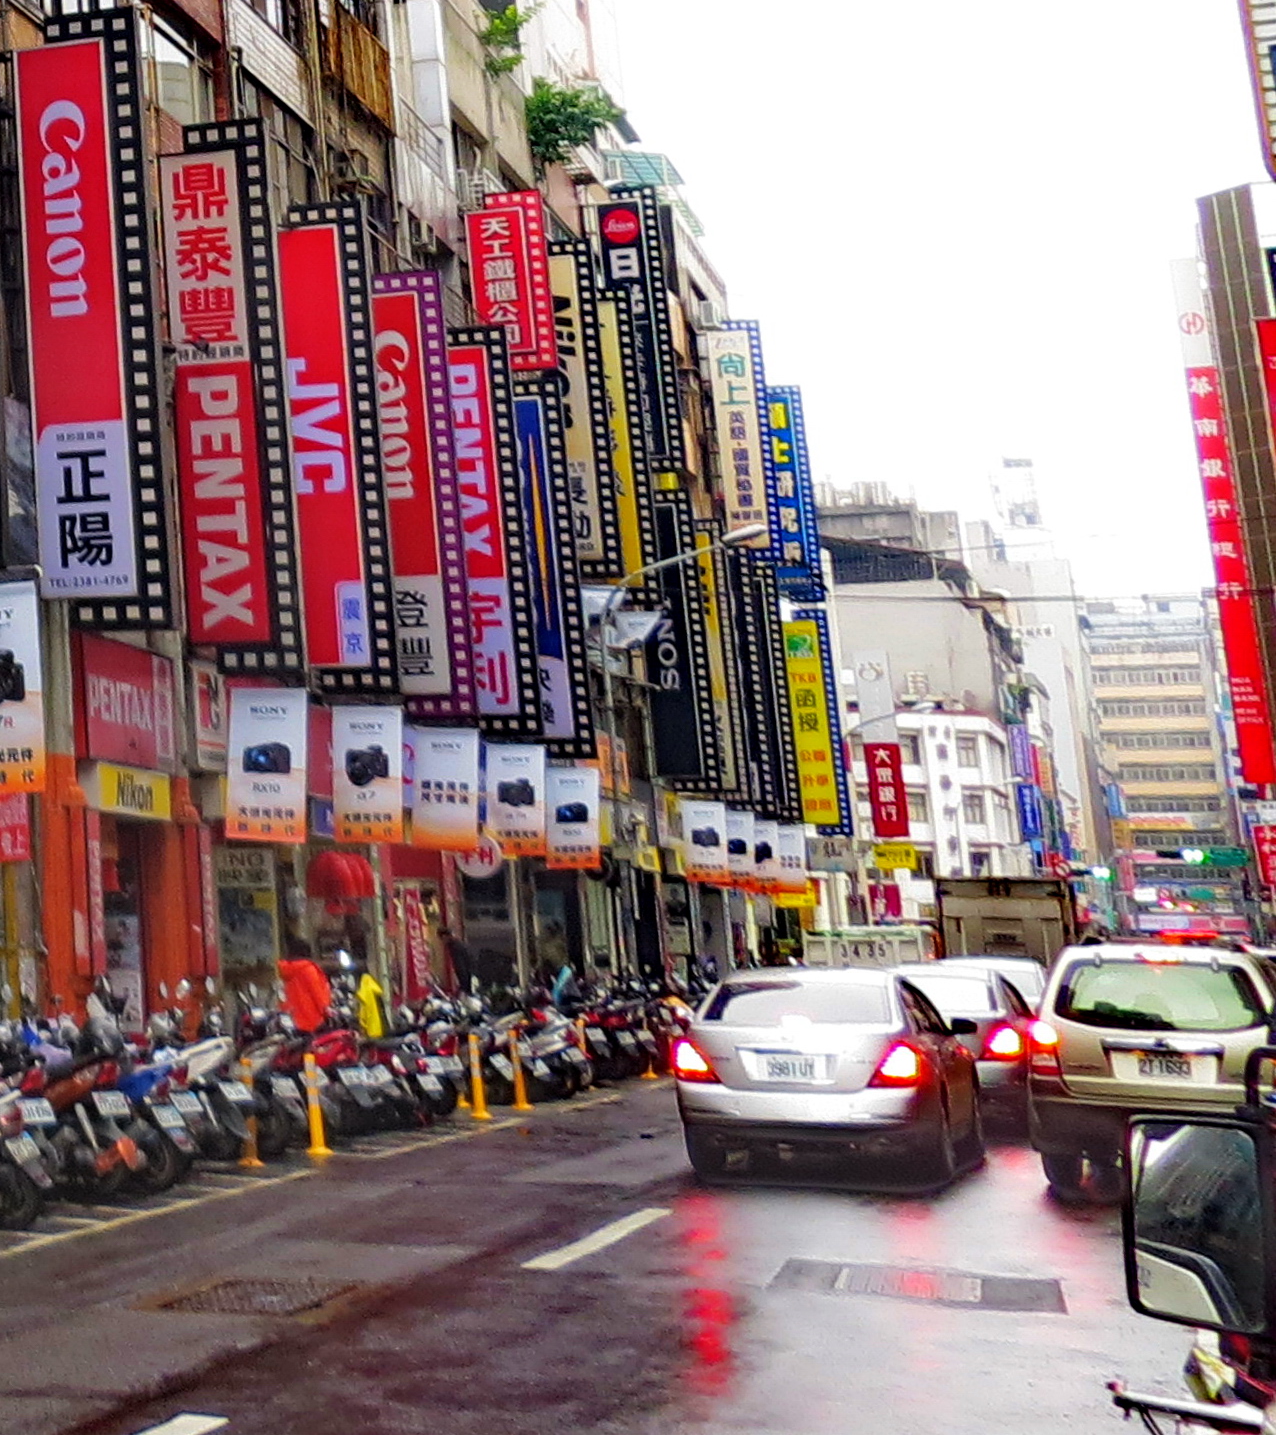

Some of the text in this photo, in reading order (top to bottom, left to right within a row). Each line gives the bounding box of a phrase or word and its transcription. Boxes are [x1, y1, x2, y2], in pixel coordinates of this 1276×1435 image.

[38, 98, 89, 319] Canon
[286, 357, 349, 495] JVC
[374, 329, 416, 501] Canon
[56, 448, 114, 570] 正陽
[187, 373, 255, 630] PENTAX
[88, 676, 153, 731] PENTAX
[250, 705, 288, 716] SONY
[349, 721, 385, 732] SONY
[115, 771, 154, 809] Nikon
